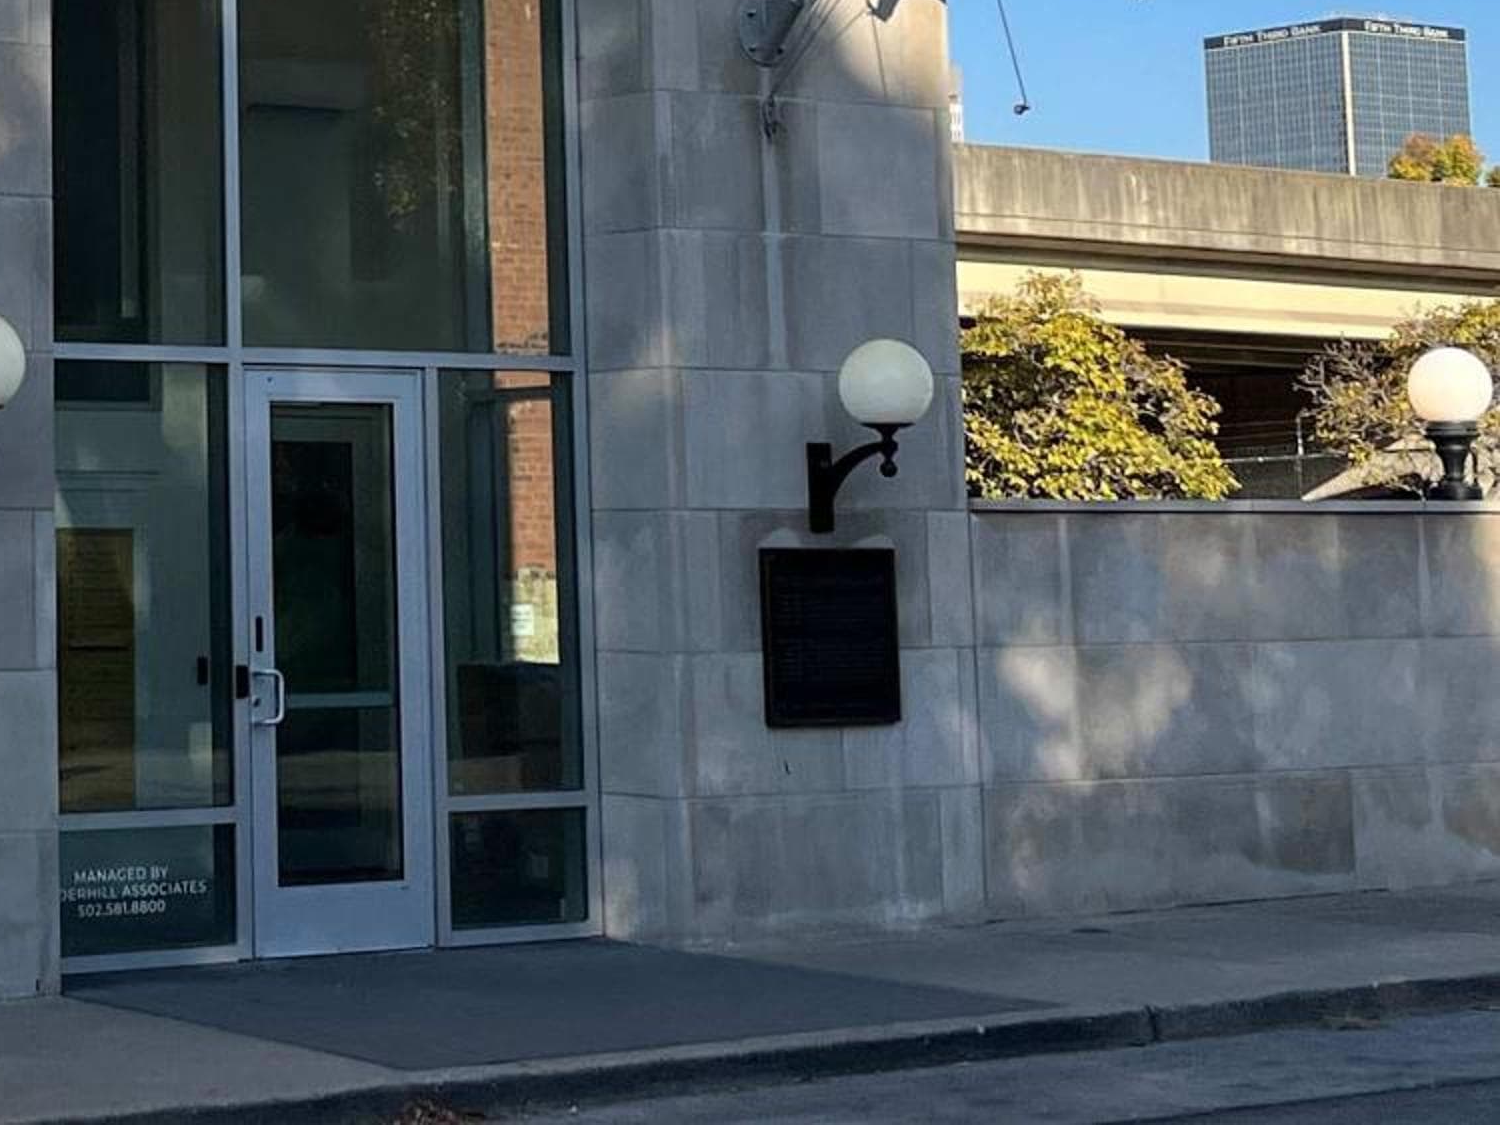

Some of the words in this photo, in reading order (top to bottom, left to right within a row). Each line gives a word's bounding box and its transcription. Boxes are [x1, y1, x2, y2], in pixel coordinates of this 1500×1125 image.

[73, 867, 147, 884] MANAGED
[150, 866, 168, 879] BY
[121, 880, 206, 897] ASSOCIATES
